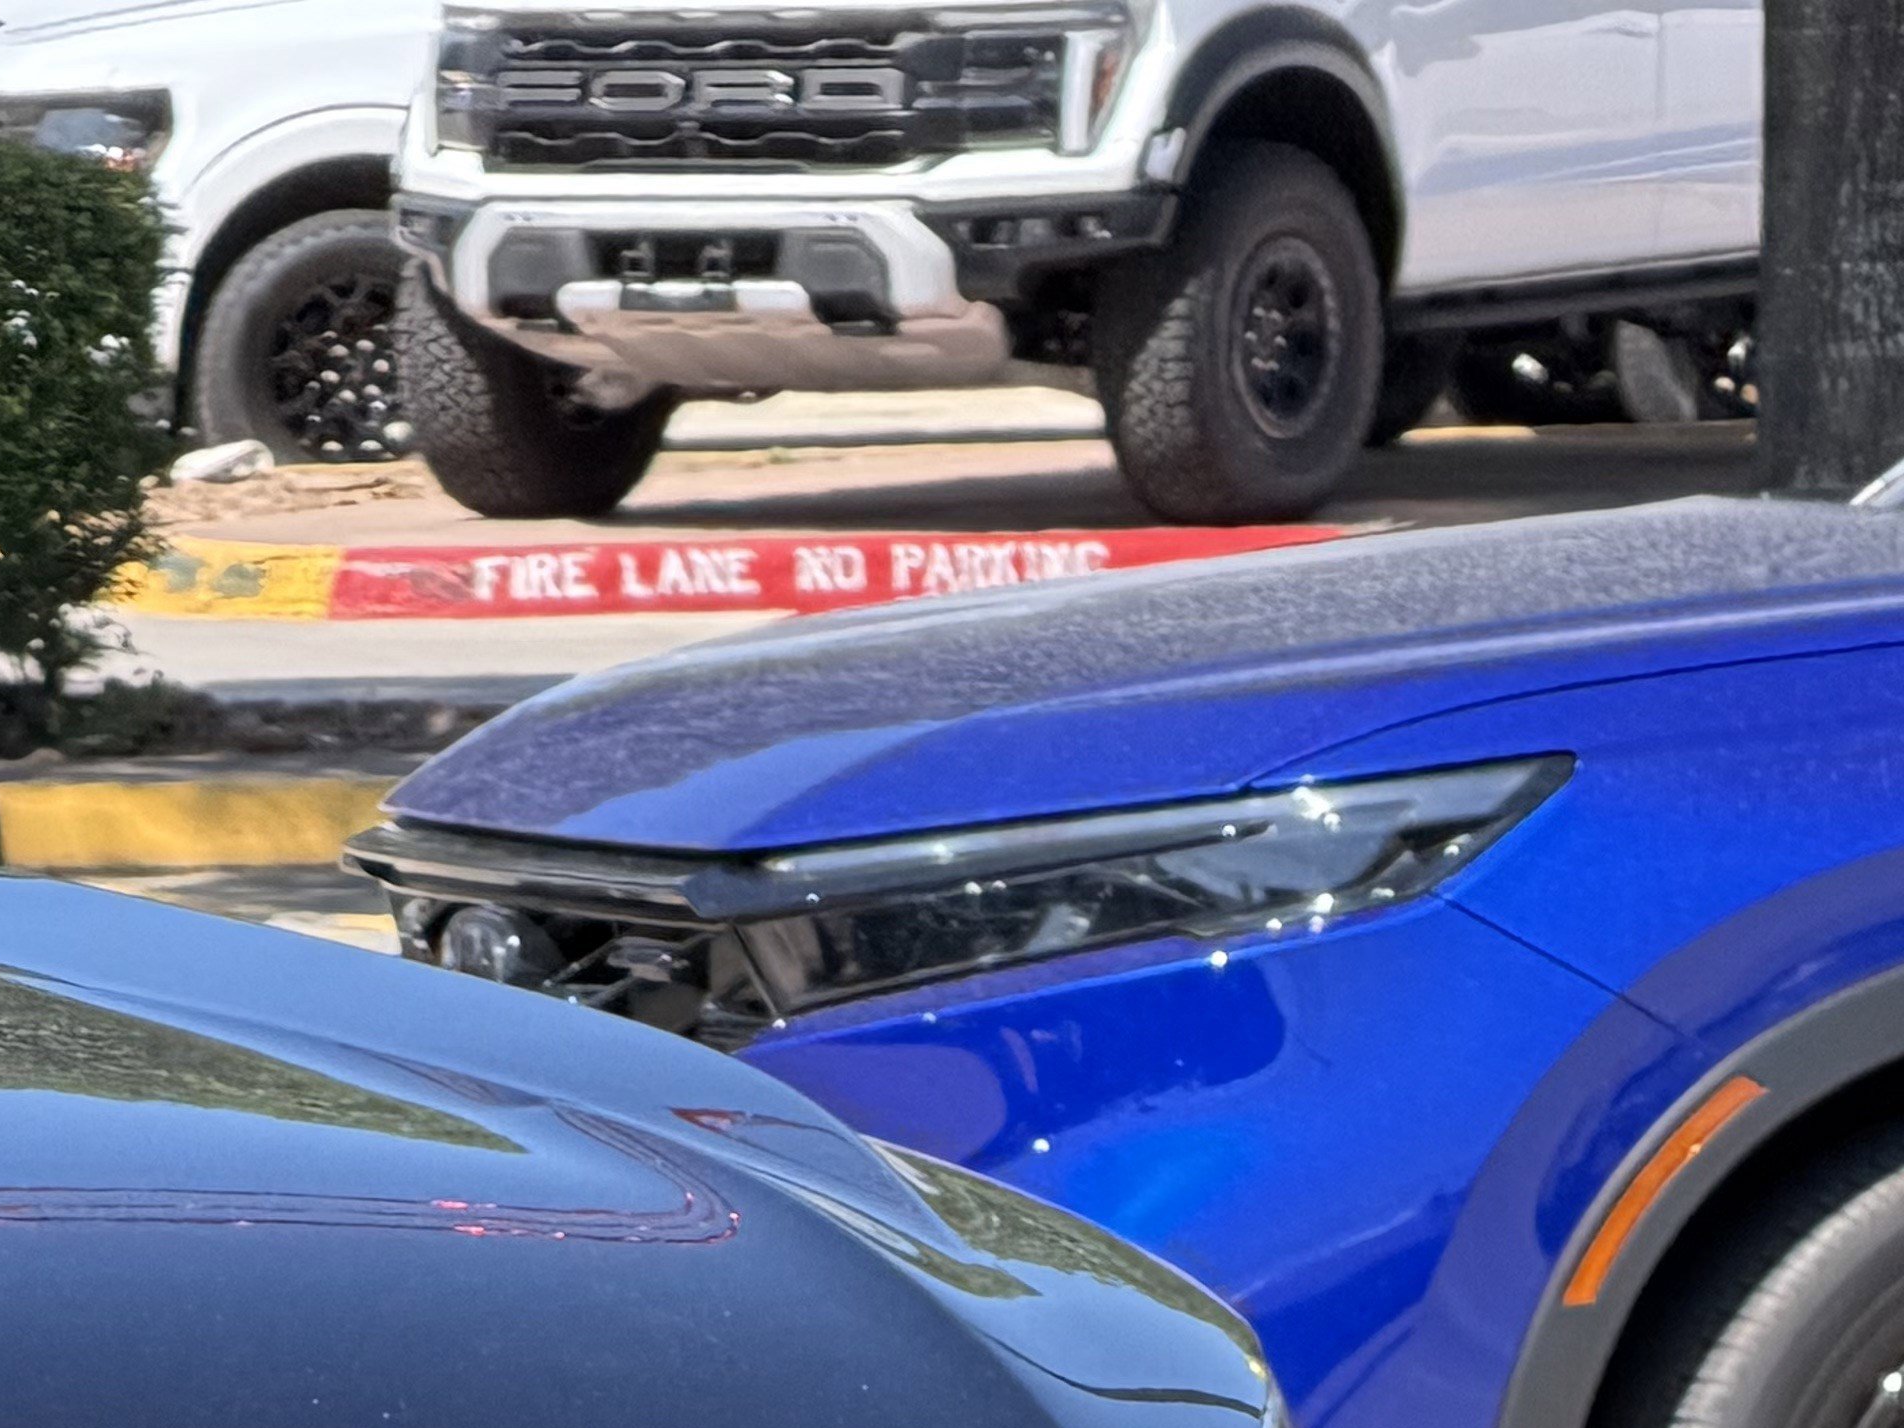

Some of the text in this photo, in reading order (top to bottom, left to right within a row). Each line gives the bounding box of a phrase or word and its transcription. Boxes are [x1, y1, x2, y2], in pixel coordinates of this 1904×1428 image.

[472, 540, 1110, 600] FIRE LANE NO PARKING
